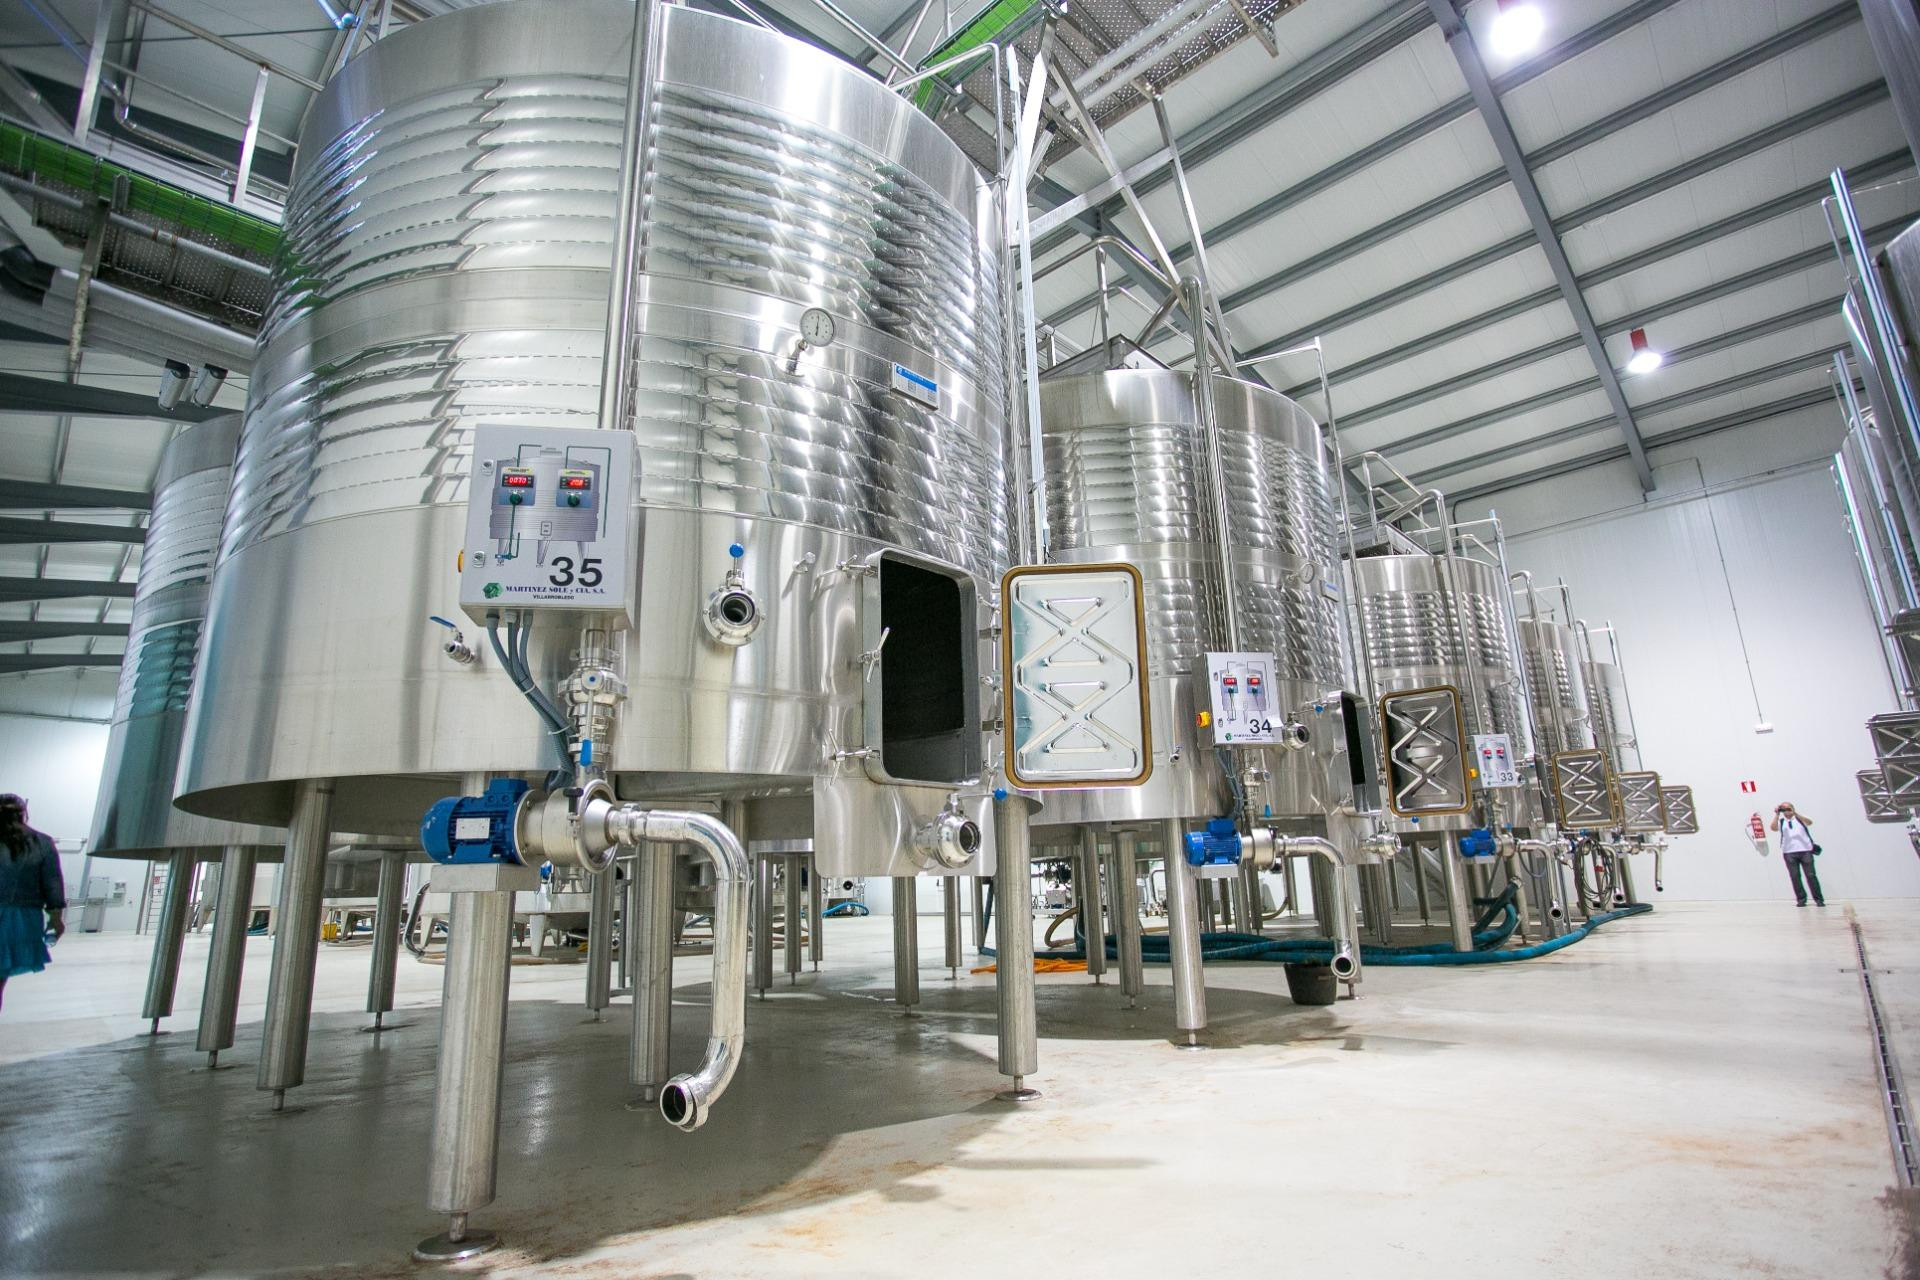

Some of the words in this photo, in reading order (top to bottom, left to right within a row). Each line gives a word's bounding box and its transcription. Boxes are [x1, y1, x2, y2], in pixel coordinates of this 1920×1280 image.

[550, 556, 603, 587] 35
[506, 585, 546, 593] MARTINEZ
[1250, 719, 1272, 734] 34
[1500, 772, 1514, 782] 33
